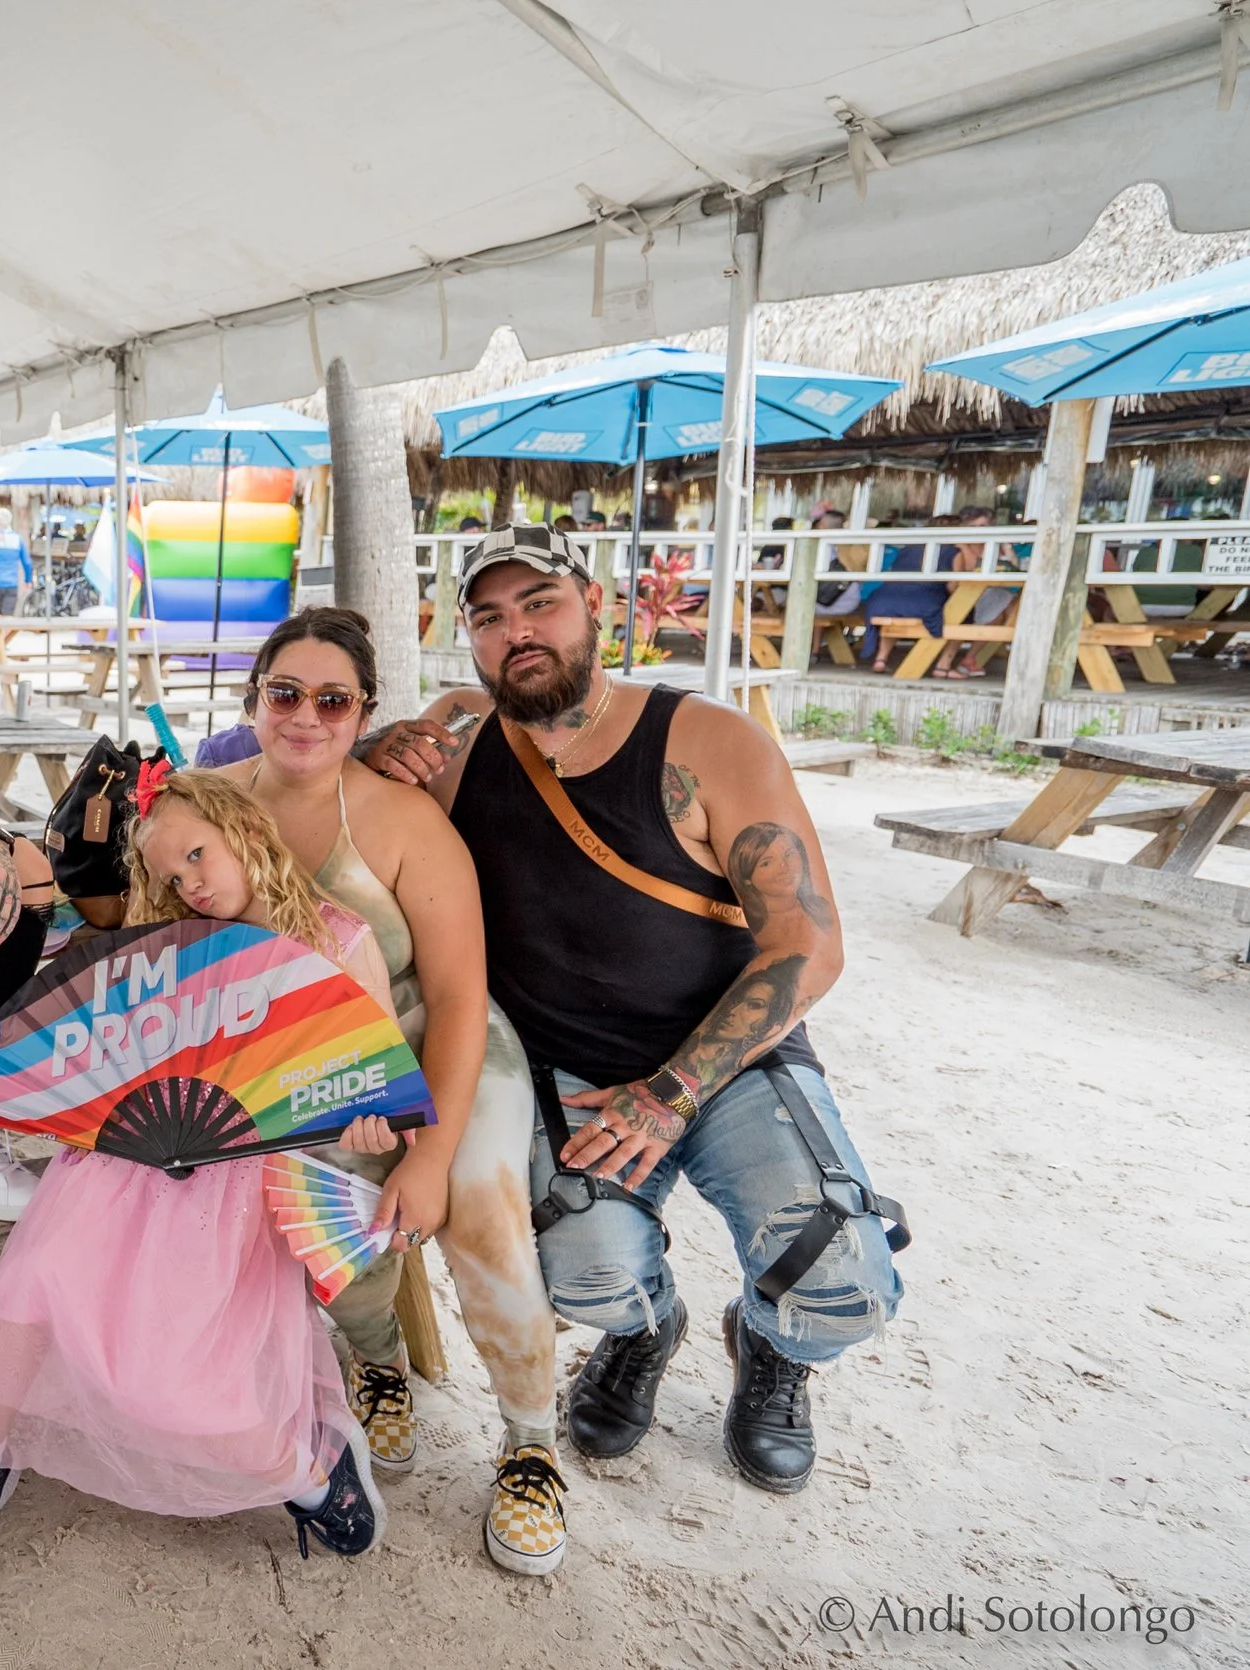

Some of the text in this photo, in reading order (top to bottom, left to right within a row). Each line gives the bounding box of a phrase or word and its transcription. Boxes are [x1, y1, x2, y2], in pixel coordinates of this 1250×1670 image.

[569, 820, 610, 862] MCM
[709, 901, 742, 921] MCM
[92, 943, 177, 1014] I'M
[51, 977, 270, 1078] PROUD
[278, 1049, 362, 1089] PROJECT
[290, 1062, 387, 1113] PRIDE
[291, 1089, 389, 1123] Celebrate. Unite. Support.
